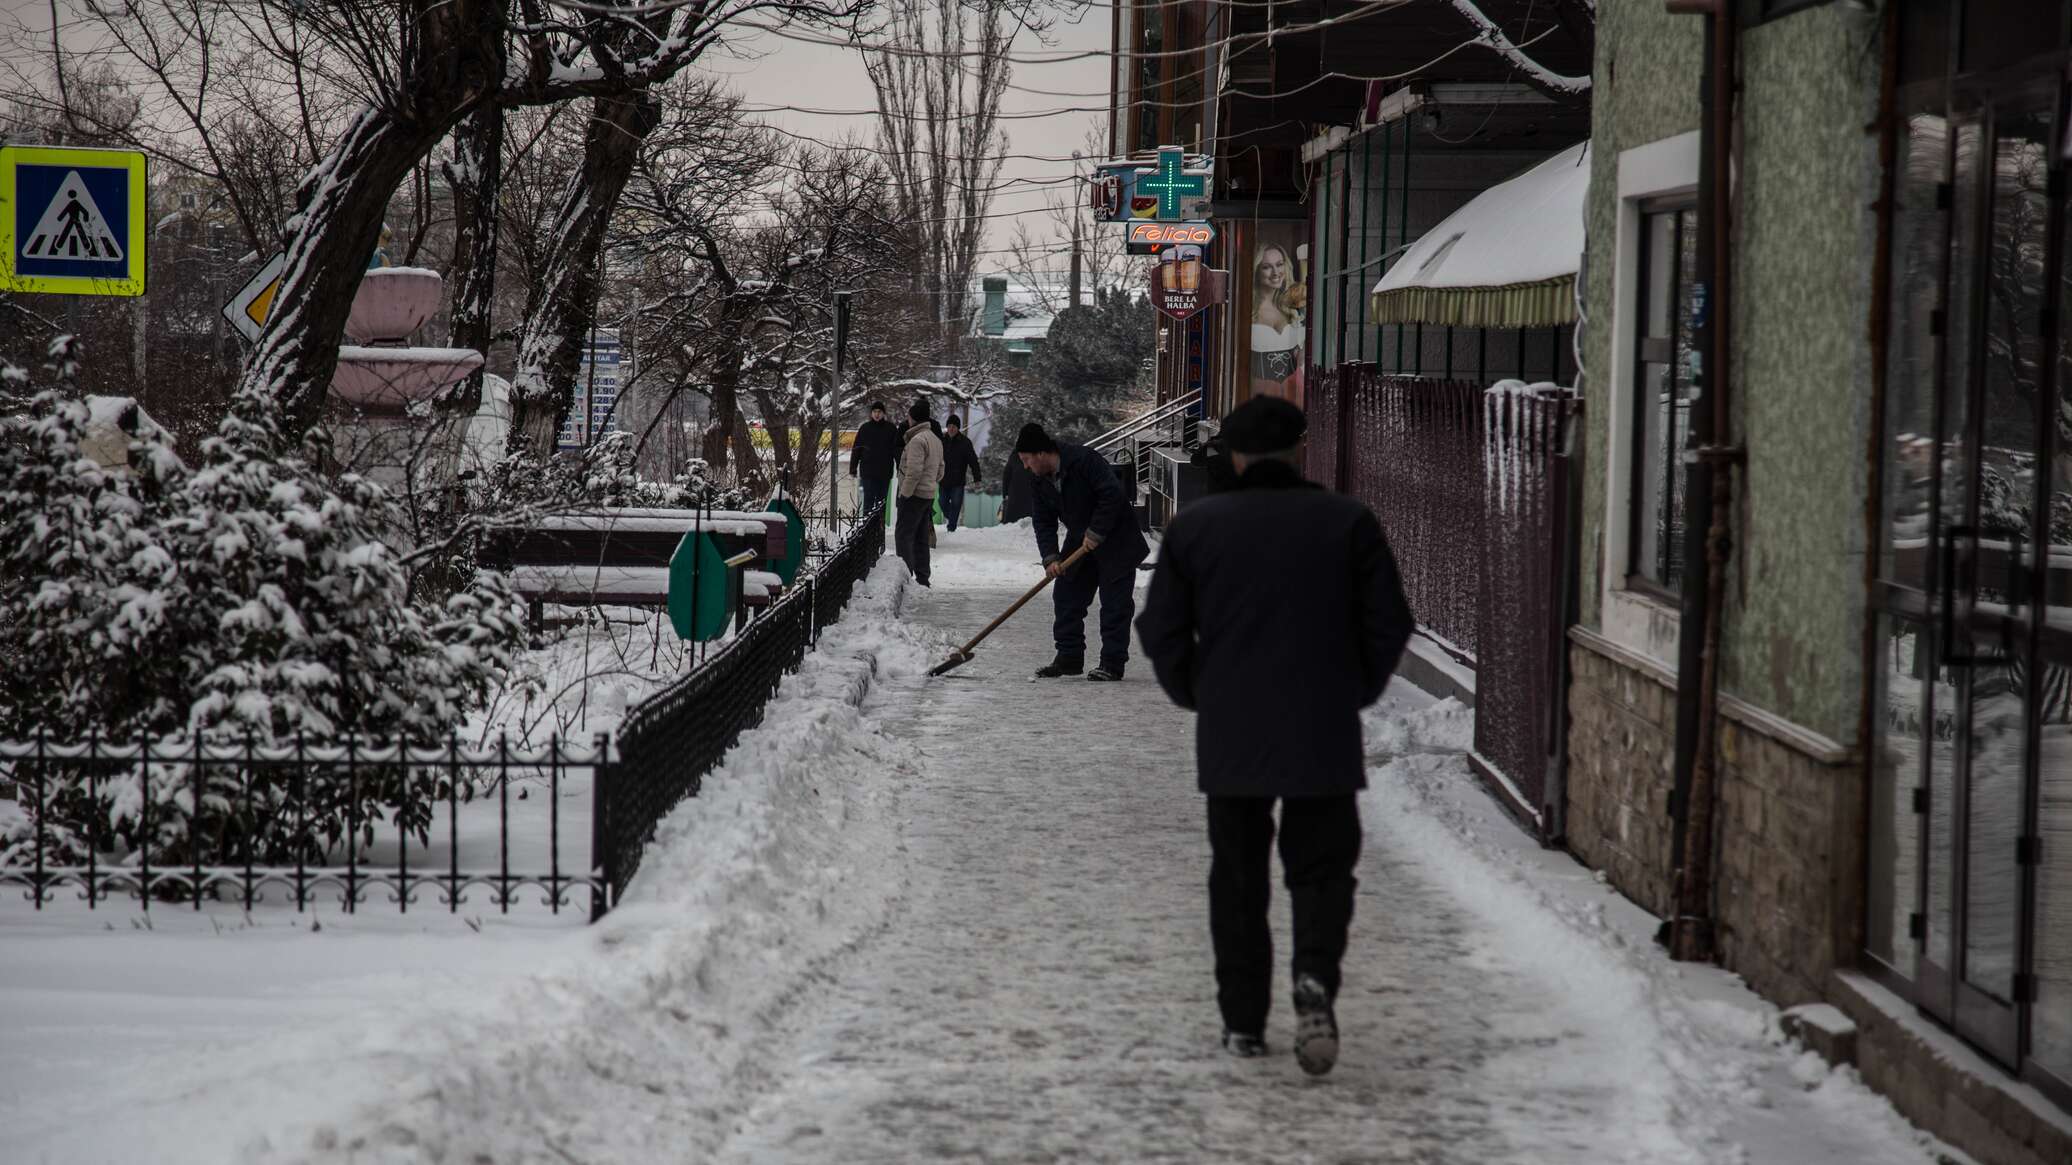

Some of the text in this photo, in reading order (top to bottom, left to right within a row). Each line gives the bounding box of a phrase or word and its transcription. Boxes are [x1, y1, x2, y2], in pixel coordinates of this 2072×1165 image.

[1131, 223, 1209, 241] Felicia
[1164, 295, 1197, 303] BERE LA
